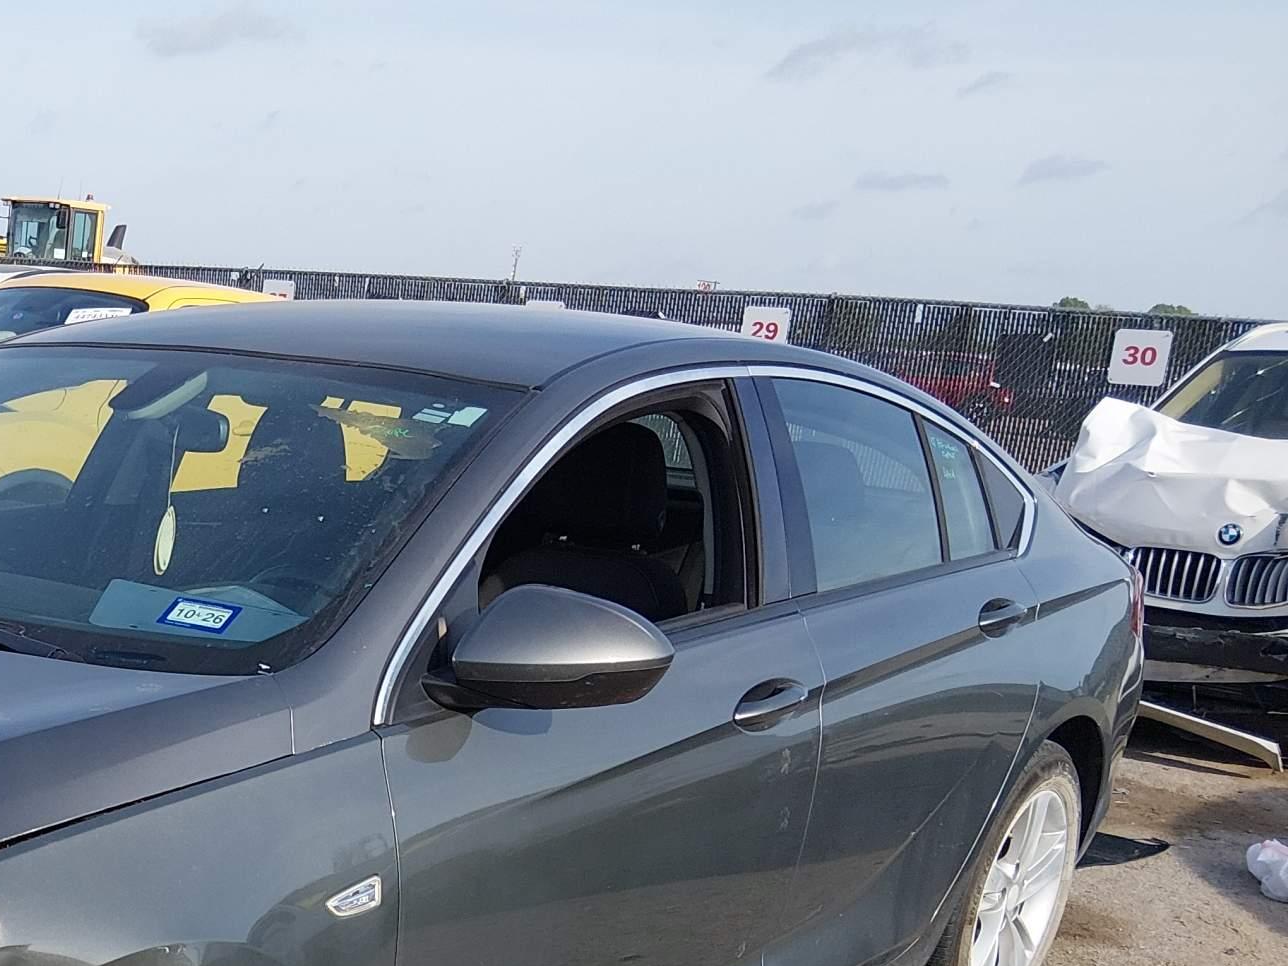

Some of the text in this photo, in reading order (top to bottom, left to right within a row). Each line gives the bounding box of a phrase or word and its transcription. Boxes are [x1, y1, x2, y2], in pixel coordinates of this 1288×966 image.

[751, 321, 779, 340] 29
[1122, 345, 1158, 366] 30
[176, 608, 196, 619] 10
[202, 612, 226, 625] 26
